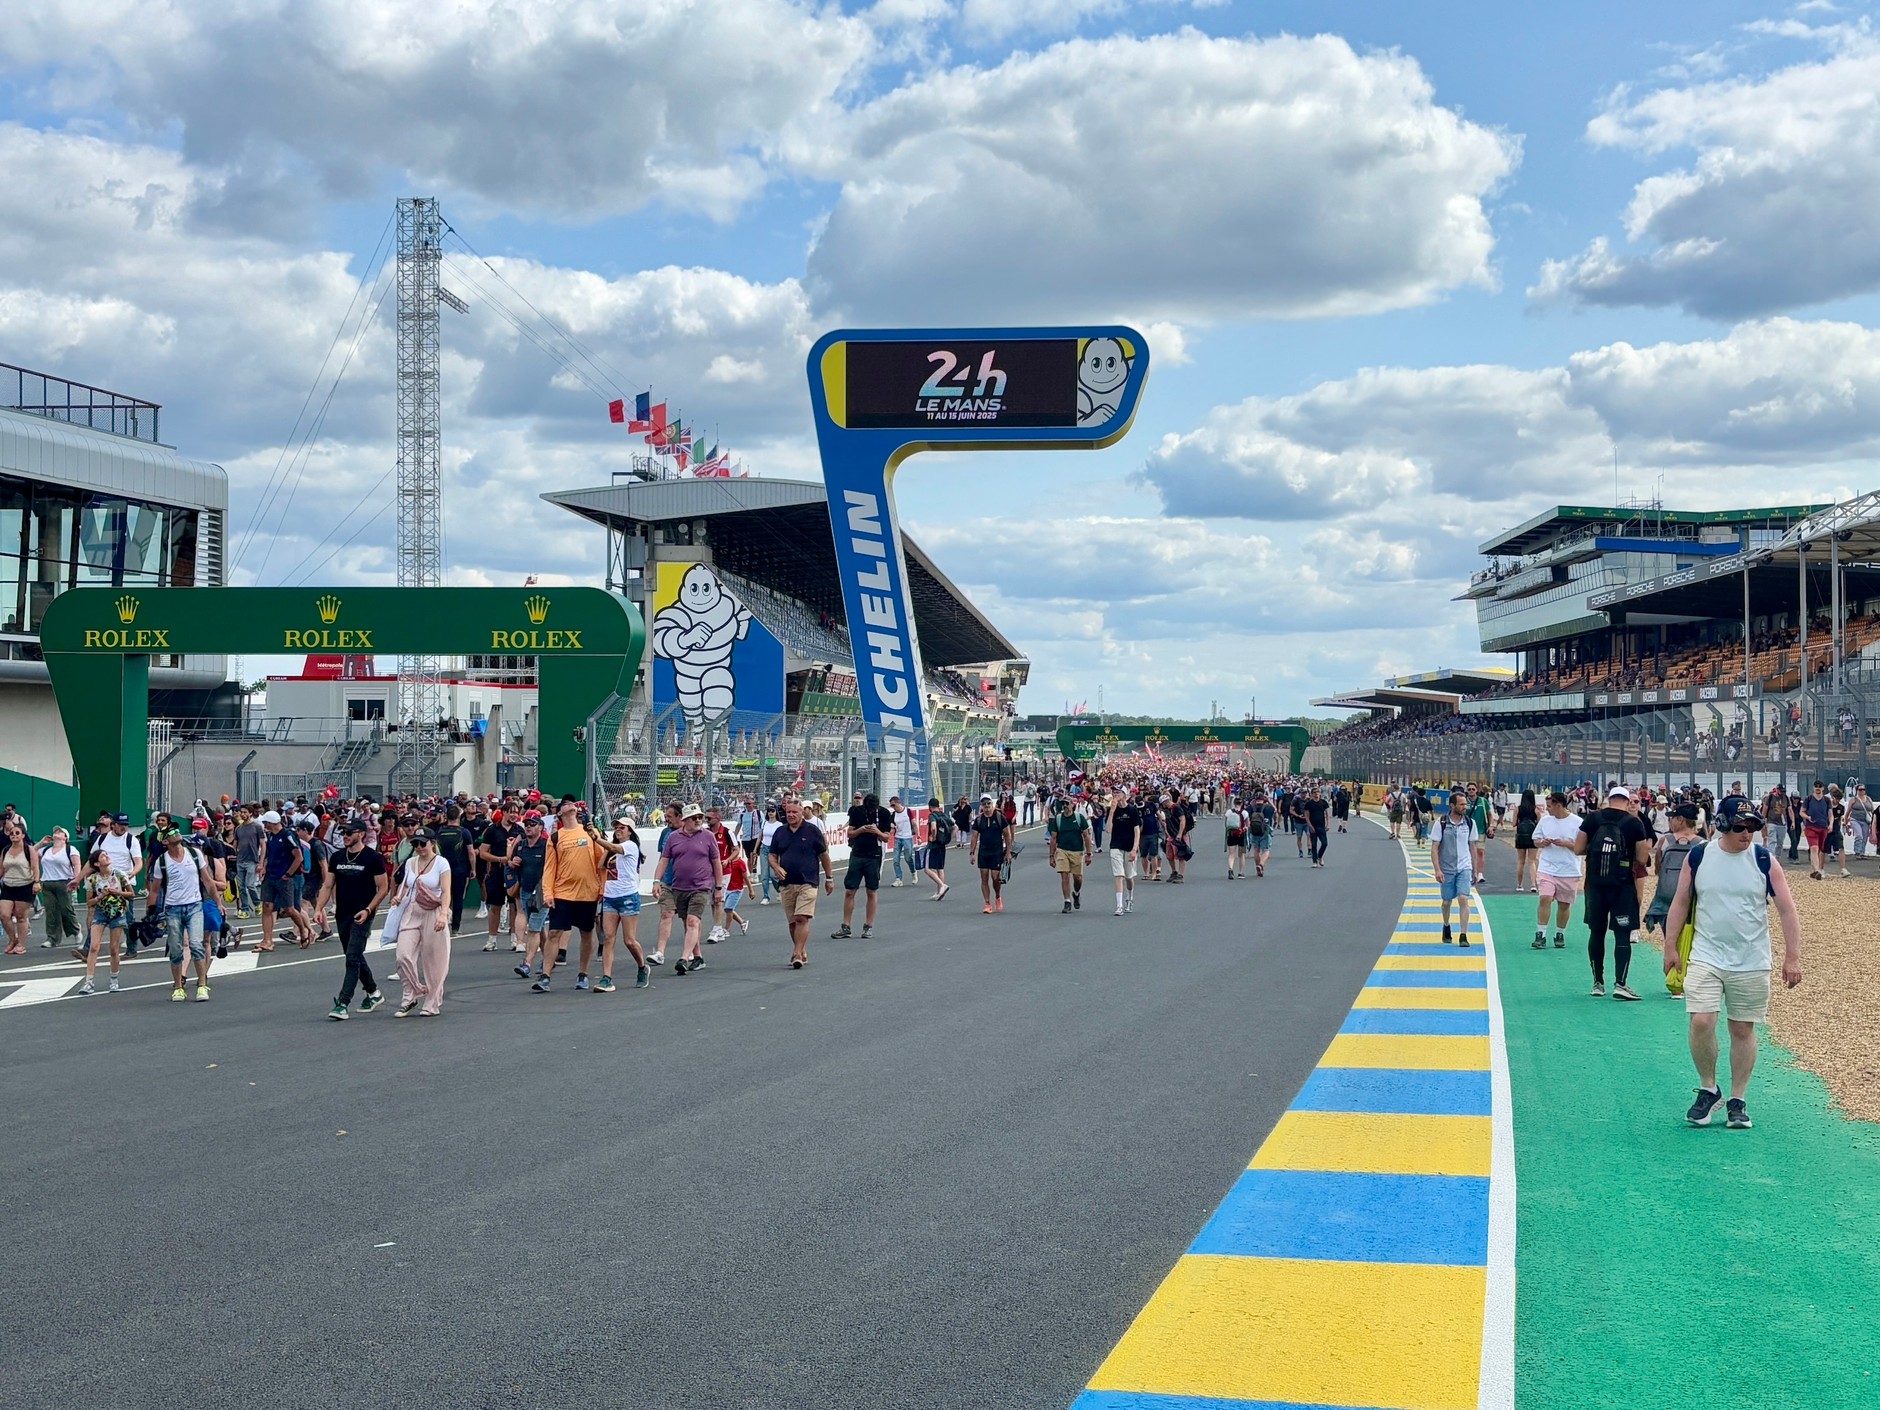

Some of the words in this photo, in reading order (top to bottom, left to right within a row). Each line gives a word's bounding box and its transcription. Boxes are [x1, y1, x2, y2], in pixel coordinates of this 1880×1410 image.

[919, 350, 1007, 397] 24h
[915, 399, 941, 412] LE
[943, 398, 1001, 412] MANS
[927, 412, 934, 420] 11
[935, 412, 947, 420] AU
[949, 412, 958, 420] 15
[958, 412, 976, 421] JUIN
[977, 412, 997, 420] 2025
[1709, 555, 1747, 575] PORSCHE
[1663, 569, 1696, 586] PORSCHE
[1626, 580, 1655, 596] PORSCHE
[1591, 591, 1616, 606] PORSCHE
[84, 630, 170, 647] ROLEX
[283, 630, 373, 648] ROLEX
[491, 630, 583, 649] ROLEX
